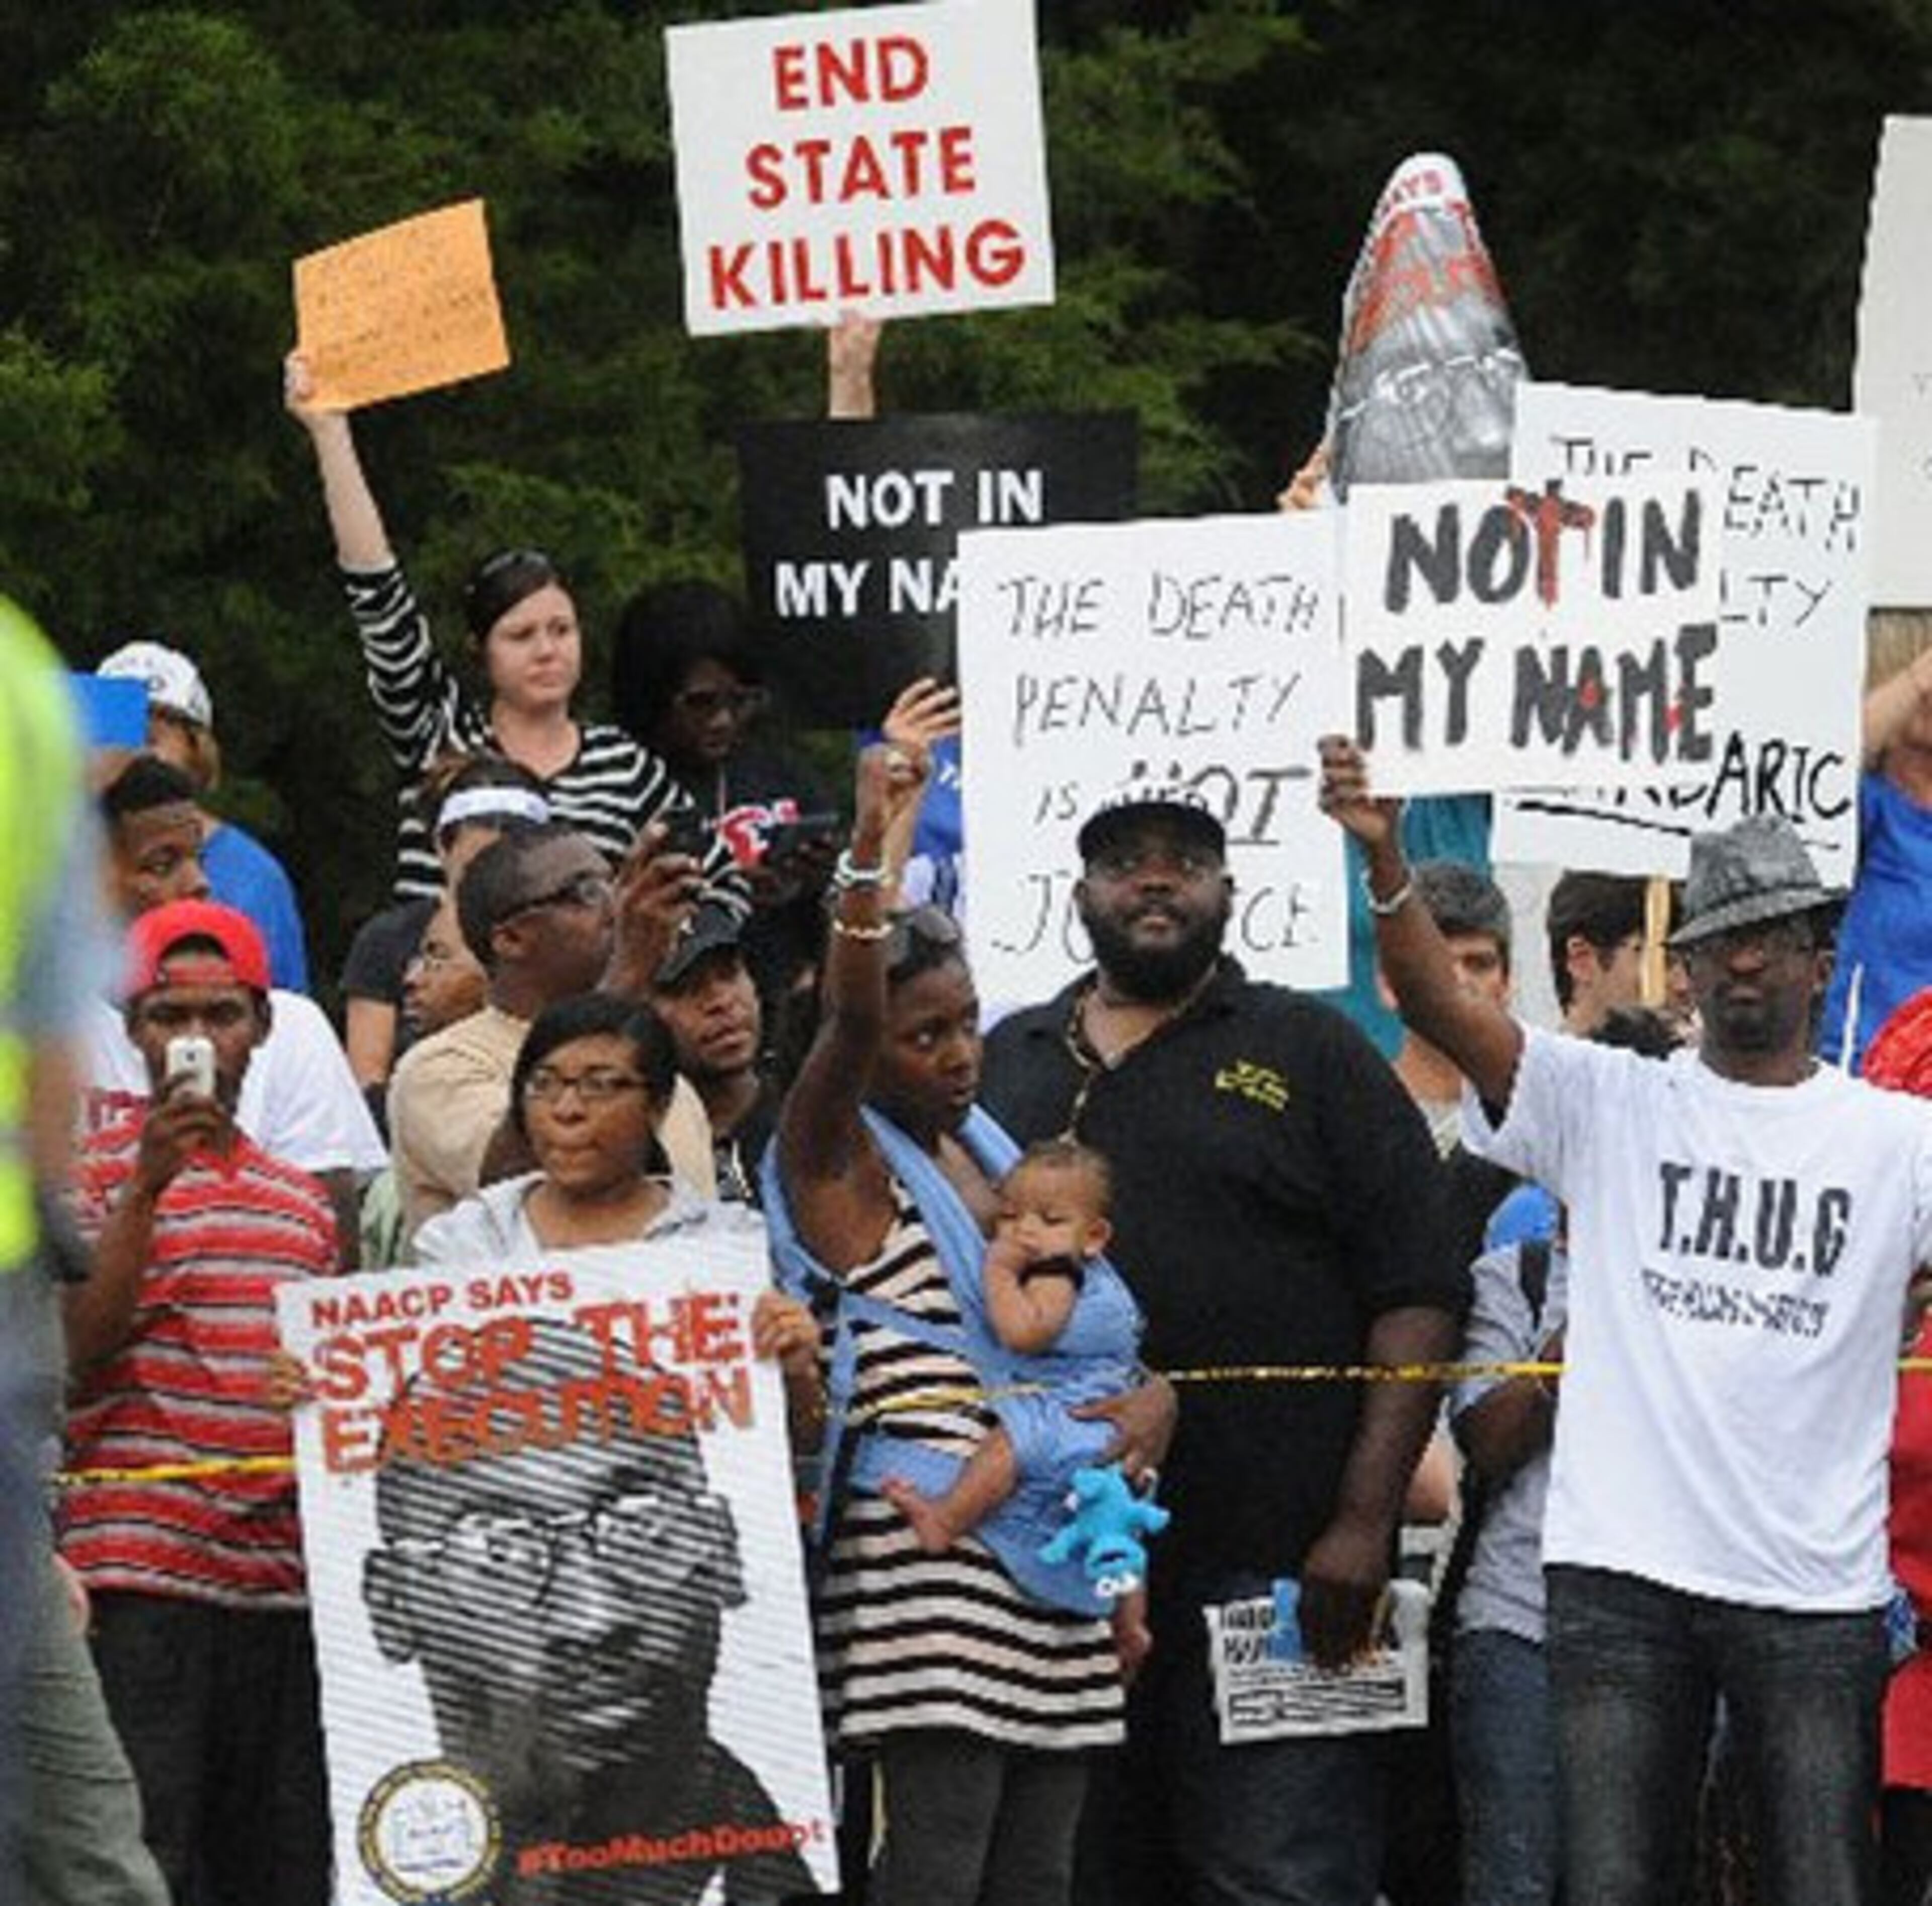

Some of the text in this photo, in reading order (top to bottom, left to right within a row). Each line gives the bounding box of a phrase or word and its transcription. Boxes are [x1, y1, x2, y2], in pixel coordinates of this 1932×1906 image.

[774, 35, 928, 110] END
[747, 127, 975, 208] STATE
[707, 218, 1025, 309] KILLING
[826, 471, 1043, 530] NOT IN
[1386, 480, 1594, 614] NOT
[1602, 488, 1700, 600] IN
[775, 562, 869, 617] MY
[998, 572, 1319, 639] THE DEATH
[1012, 673, 1301, 747] PENALTY
[1356, 623, 1718, 765] MY NAME
[1034, 760, 1312, 845] IS OT
[1659, 1161, 1852, 1277] T.H.U.G
[311, 1272, 575, 1328] NAACP SAYS
[312, 1294, 746, 1402] STOP THE
[320, 1367, 755, 1476] EXECUTION
